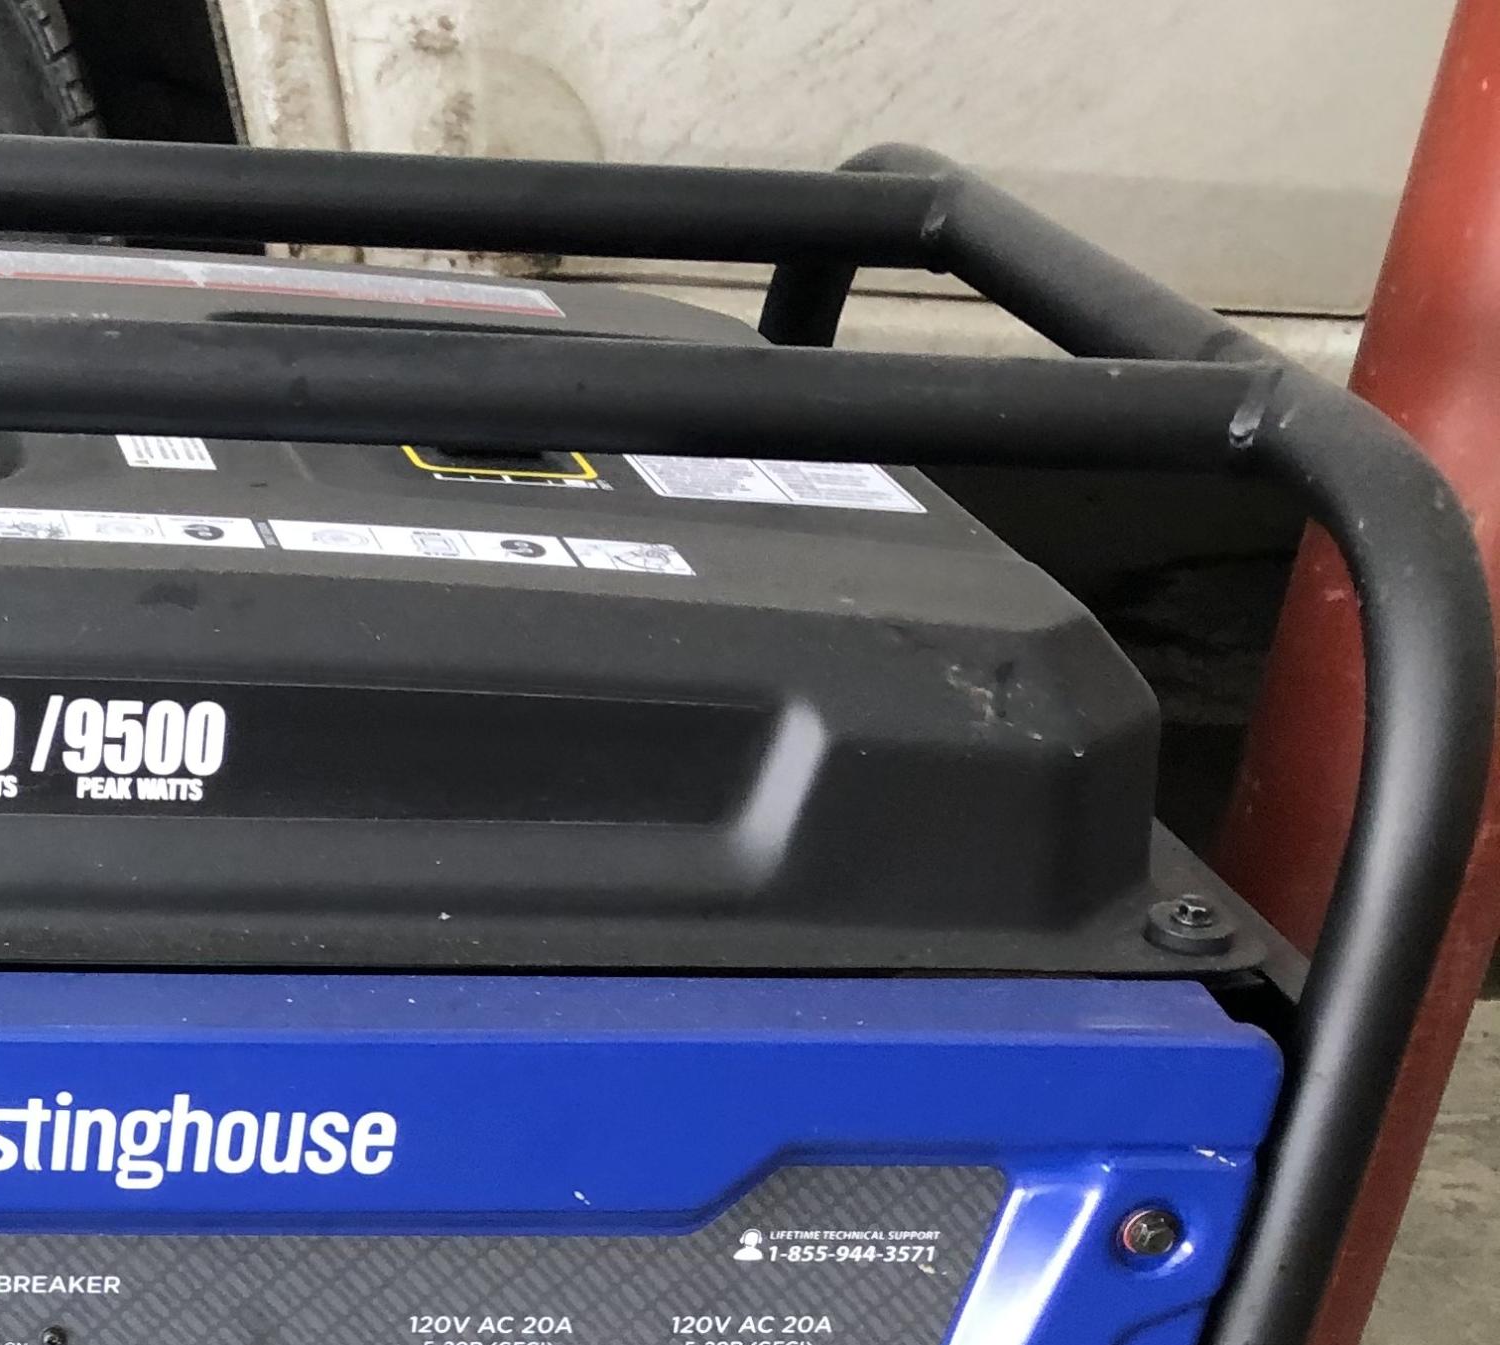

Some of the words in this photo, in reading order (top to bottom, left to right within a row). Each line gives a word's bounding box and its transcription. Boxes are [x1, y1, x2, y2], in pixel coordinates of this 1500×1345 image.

[30, 694, 227, 775] /9500
[76, 775, 134, 801] PEAK
[136, 777, 204, 802] WATTS
[769, 1230, 822, 1241] LIFETIME
[822, 1230, 886, 1241] TECHNICAL
[887, 1230, 941, 1241] SUPPORT
[768, 1245, 936, 1263] 1-855-944-3571
[409, 1315, 471, 1334] 120V
[477, 1315, 515, 1334] AC
[521, 1316, 573, 1335] 20A
[671, 1315, 732, 1334] 120V
[737, 1315, 776, 1334] AC
[781, 1315, 833, 1334] 20A
